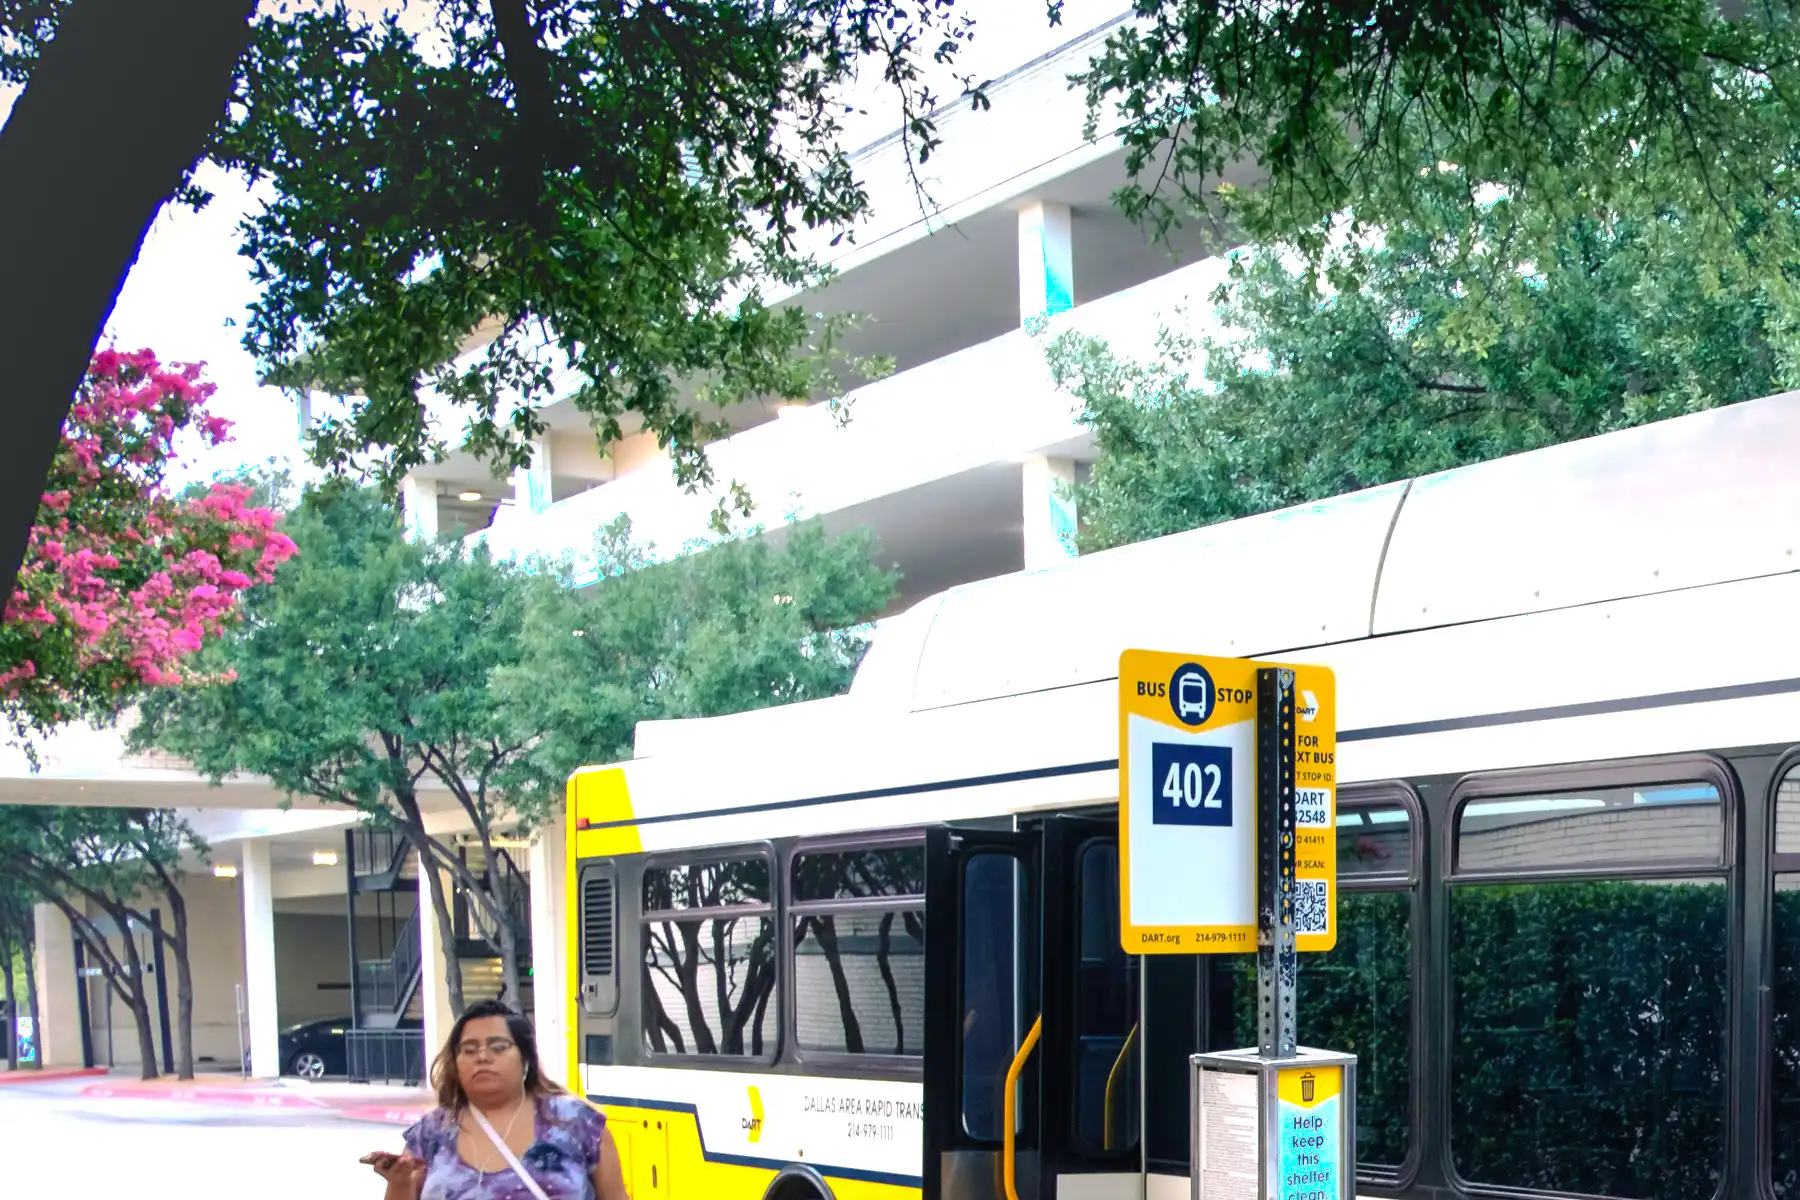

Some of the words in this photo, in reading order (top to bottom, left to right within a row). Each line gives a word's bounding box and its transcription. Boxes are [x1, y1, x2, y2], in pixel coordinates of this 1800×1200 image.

[1137, 681, 1166, 698] BUS
[1218, 688, 1253, 704] STOP
[1298, 735, 1319, 748] FOR
[1296, 751, 1311, 763] XT
[1313, 752, 1334, 764] BUS
[1303, 771, 1322, 781] STOP
[1162, 762, 1223, 809] 402
[1295, 791, 1325, 805] DART
[1304, 835, 1325, 844] 41411
[1304, 860, 1326, 869] SCAN:
[1142, 932, 1181, 945] DART.org
[1195, 932, 1247, 943] 214-979-1111
[804, 1095, 836, 1114] DALLAS
[839, 1098, 862, 1115] AREA
[865, 1099, 893, 1118] RAPID
[895, 1101, 924, 1121] TRANS
[741, 1117, 762, 1131] DART
[1293, 1115, 1323, 1131] Help
[1292, 1135, 1324, 1149] keep
[1297, 1152, 1319, 1166] this
[1287, 1170, 1330, 1186] shelter
